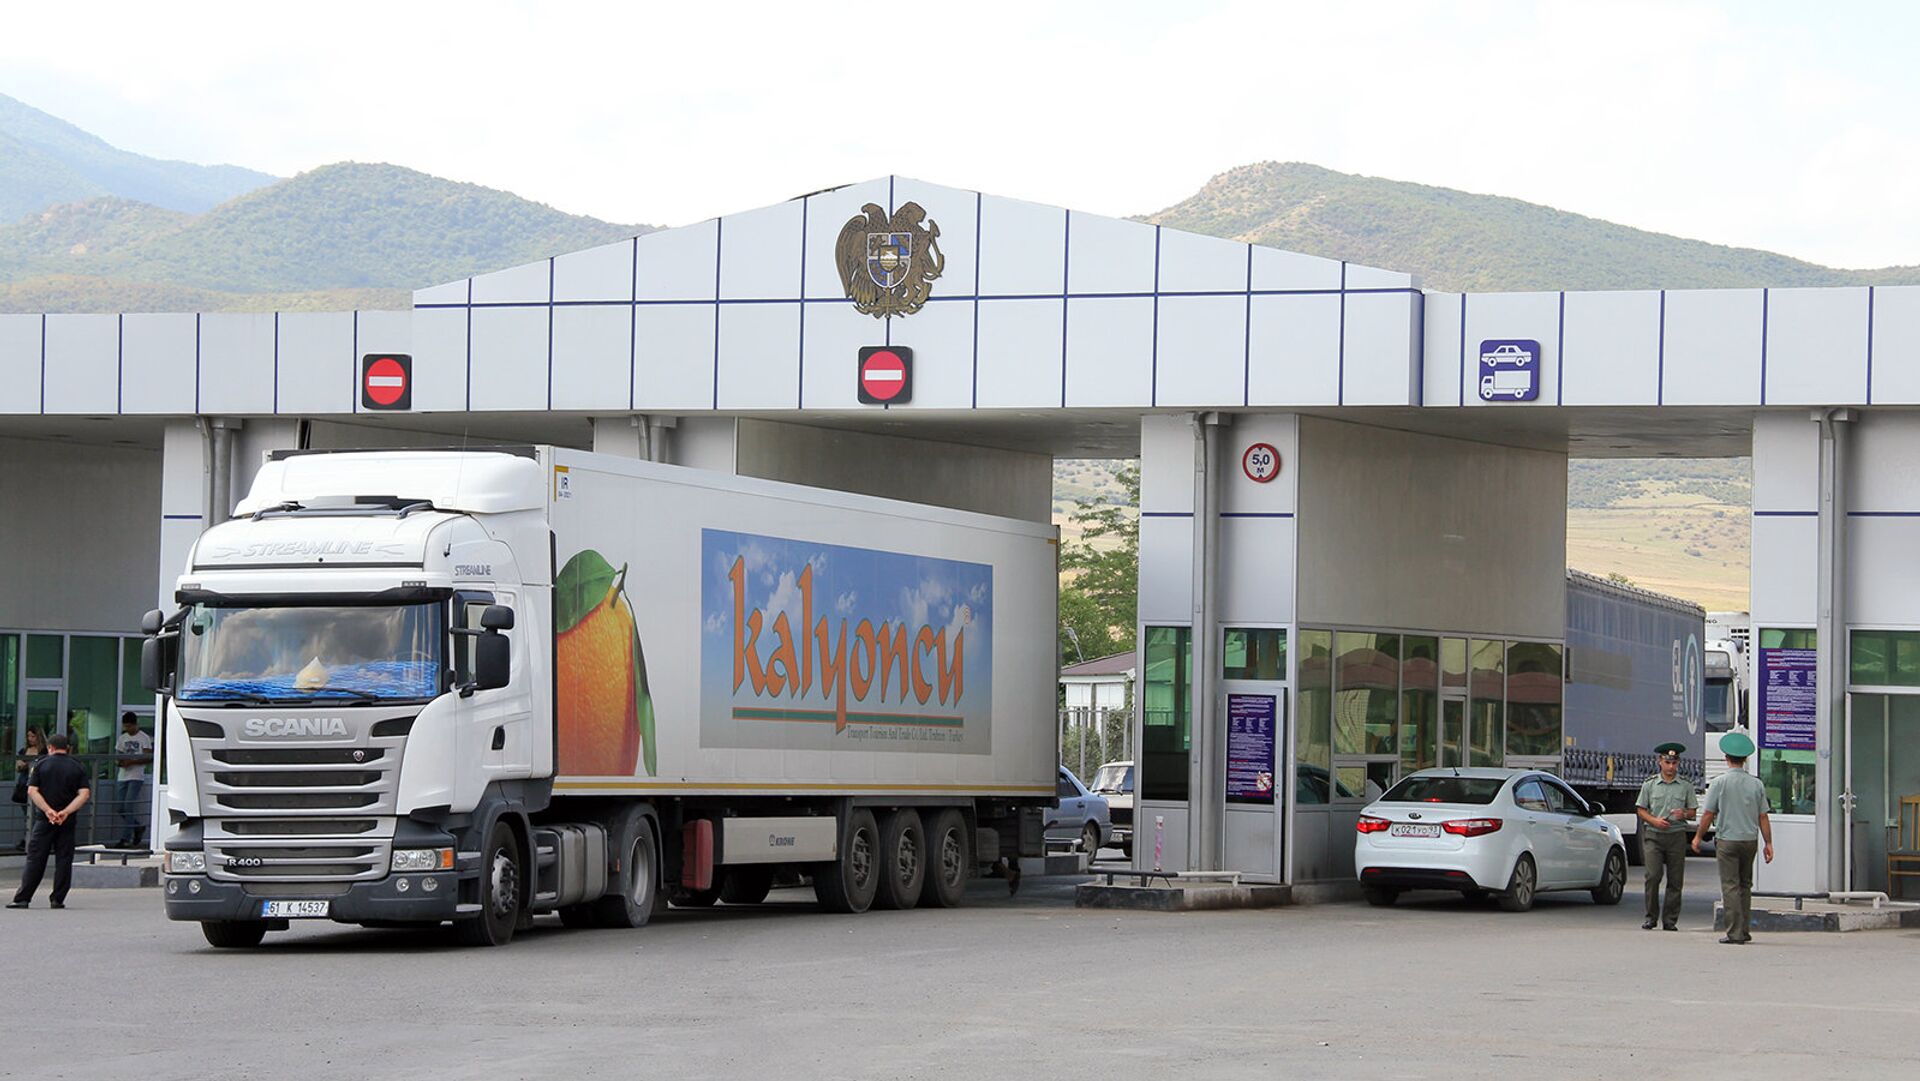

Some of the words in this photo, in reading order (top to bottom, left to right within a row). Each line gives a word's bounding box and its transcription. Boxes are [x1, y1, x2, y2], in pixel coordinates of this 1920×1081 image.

[1252, 454, 1270, 466] 5,0
[244, 541, 374, 558] STREAMLINE
[455, 564, 491, 576] STREAMLINE
[728, 555, 964, 736] kalyoncu
[244, 718, 347, 737] SCANIA
[270, 902, 280, 913] 61
[287, 902, 292, 913] K
[299, 902, 326, 913] 14537
